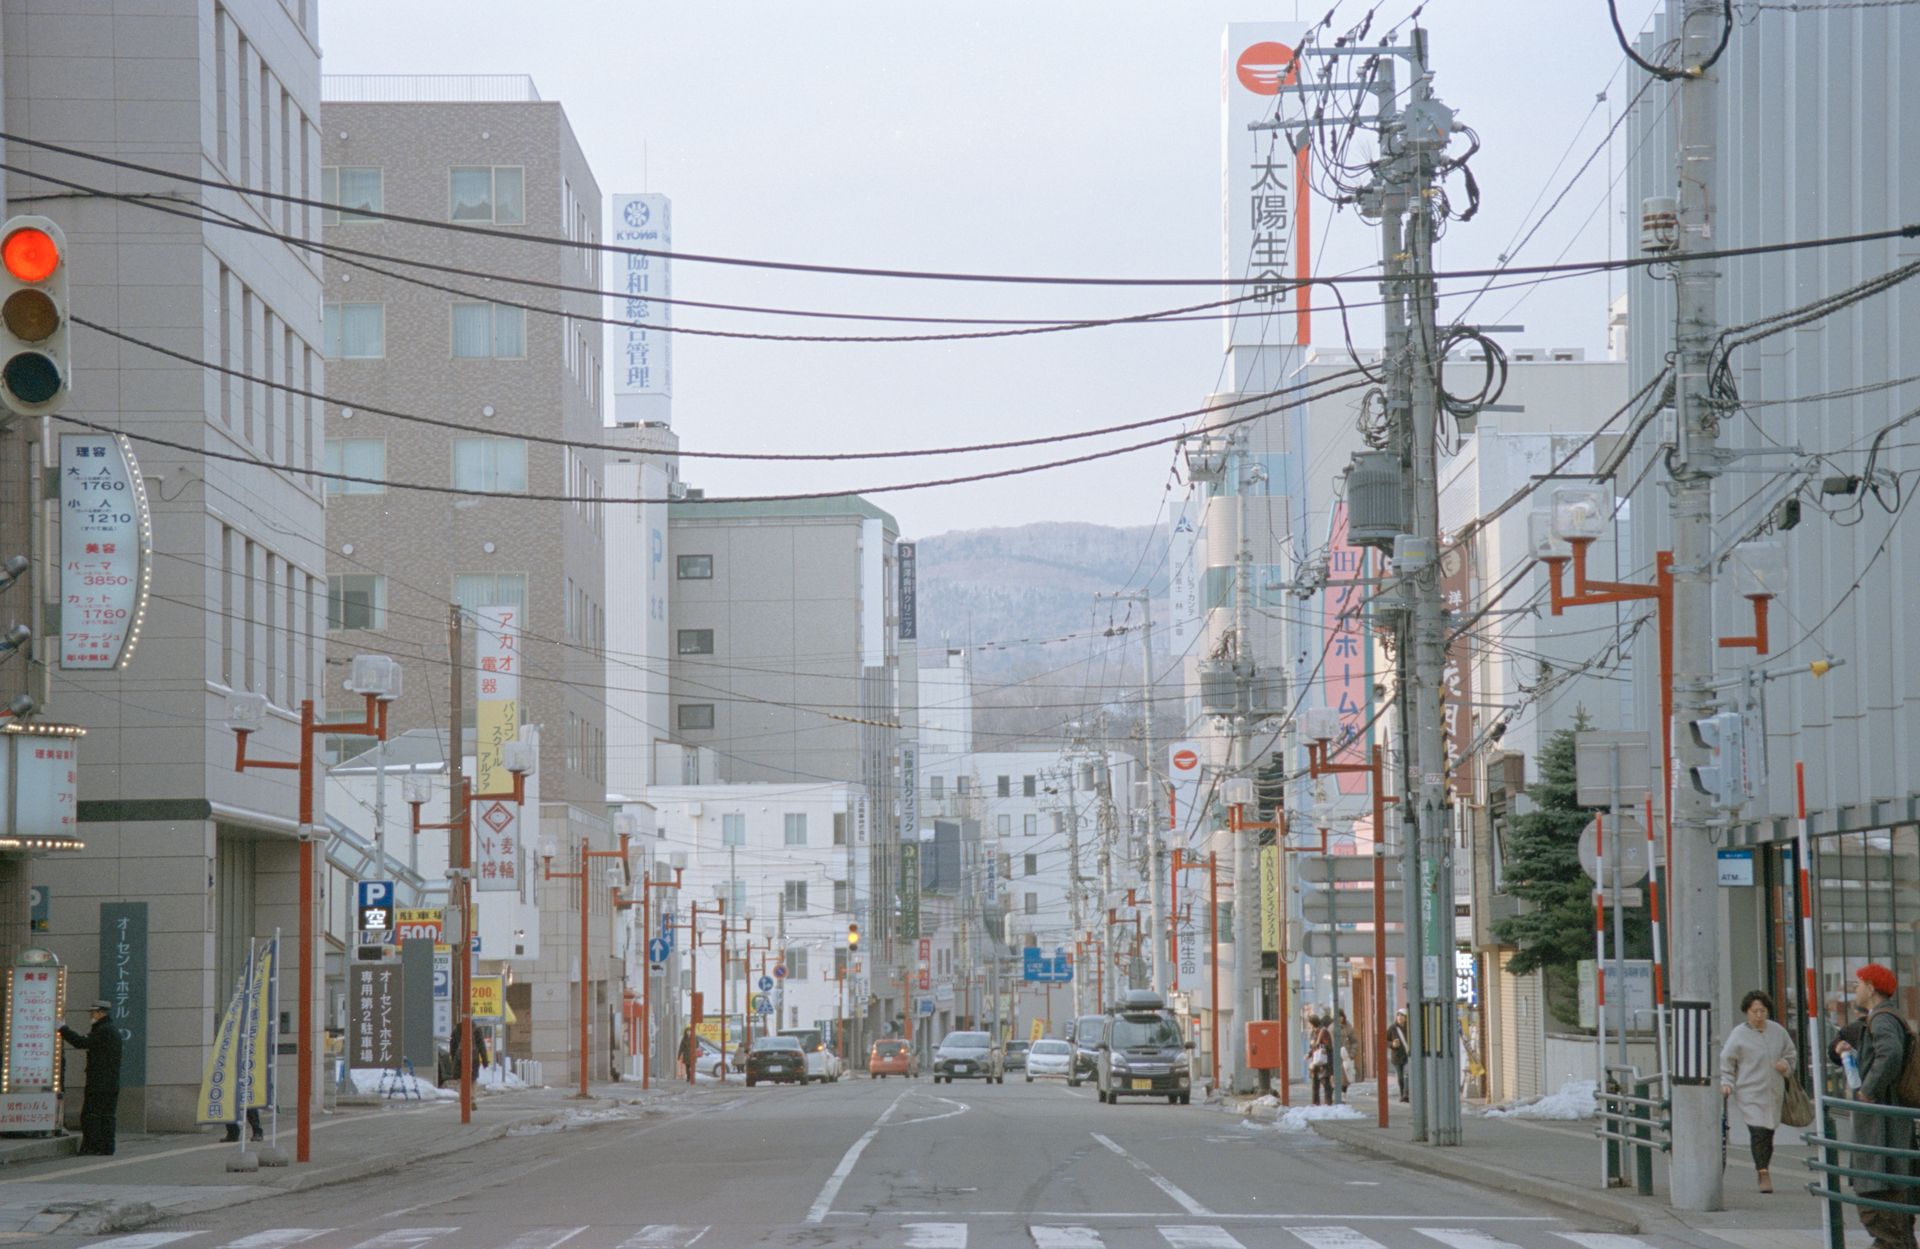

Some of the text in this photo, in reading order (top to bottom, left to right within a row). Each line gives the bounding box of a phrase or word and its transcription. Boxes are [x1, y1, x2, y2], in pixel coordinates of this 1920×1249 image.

[616, 231, 657, 240] KYOWA
[1251, 155, 1288, 305] 太陽生命
[626, 247, 650, 388] 協和総合管理
[76, 446, 106, 457] 理容
[67, 467, 111, 476] 大人
[81, 482, 125, 490] 1760
[68, 499, 112, 508] 小人
[89, 514, 131, 523] 1210
[86, 544, 116, 554] 美容
[83, 610, 127, 619] 1760
[499, 612, 514, 671] アカオ
[482, 656, 497, 694] 電器
[503, 702, 515, 741] パソコン
[492, 726, 503, 767] スクール
[481, 752, 491, 790] アルファ
[367, 884, 386, 905] P
[365, 908, 386, 929] 空
[25, 972, 47, 981] 美容
[116, 917, 130, 1018] オーセントホテル
[361, 971, 373, 1062] 専用第2駐車場
[380, 970, 392, 1062] オーセントホテル
